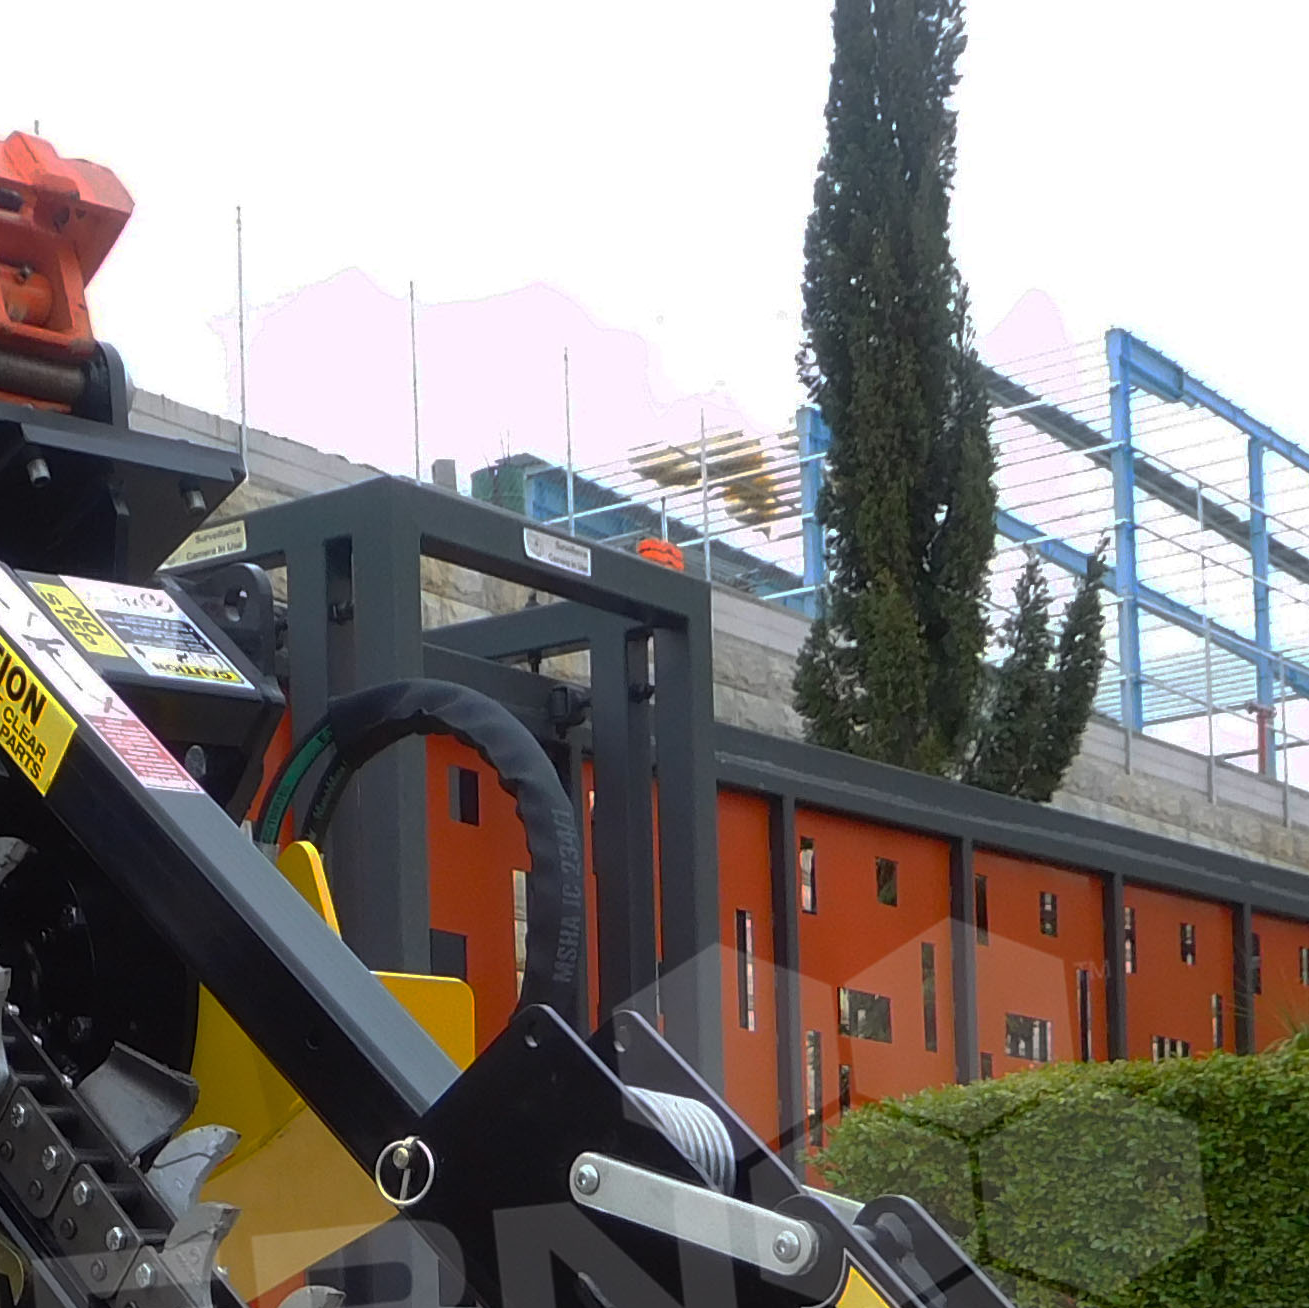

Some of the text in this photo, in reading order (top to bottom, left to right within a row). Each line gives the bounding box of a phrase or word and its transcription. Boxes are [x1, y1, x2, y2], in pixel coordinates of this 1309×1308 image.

[39, 591, 98, 645] STEP
[67, 606, 104, 636] NO
[3, 706, 46, 762] CLEAR
[552, 915, 581, 982] MSHA
